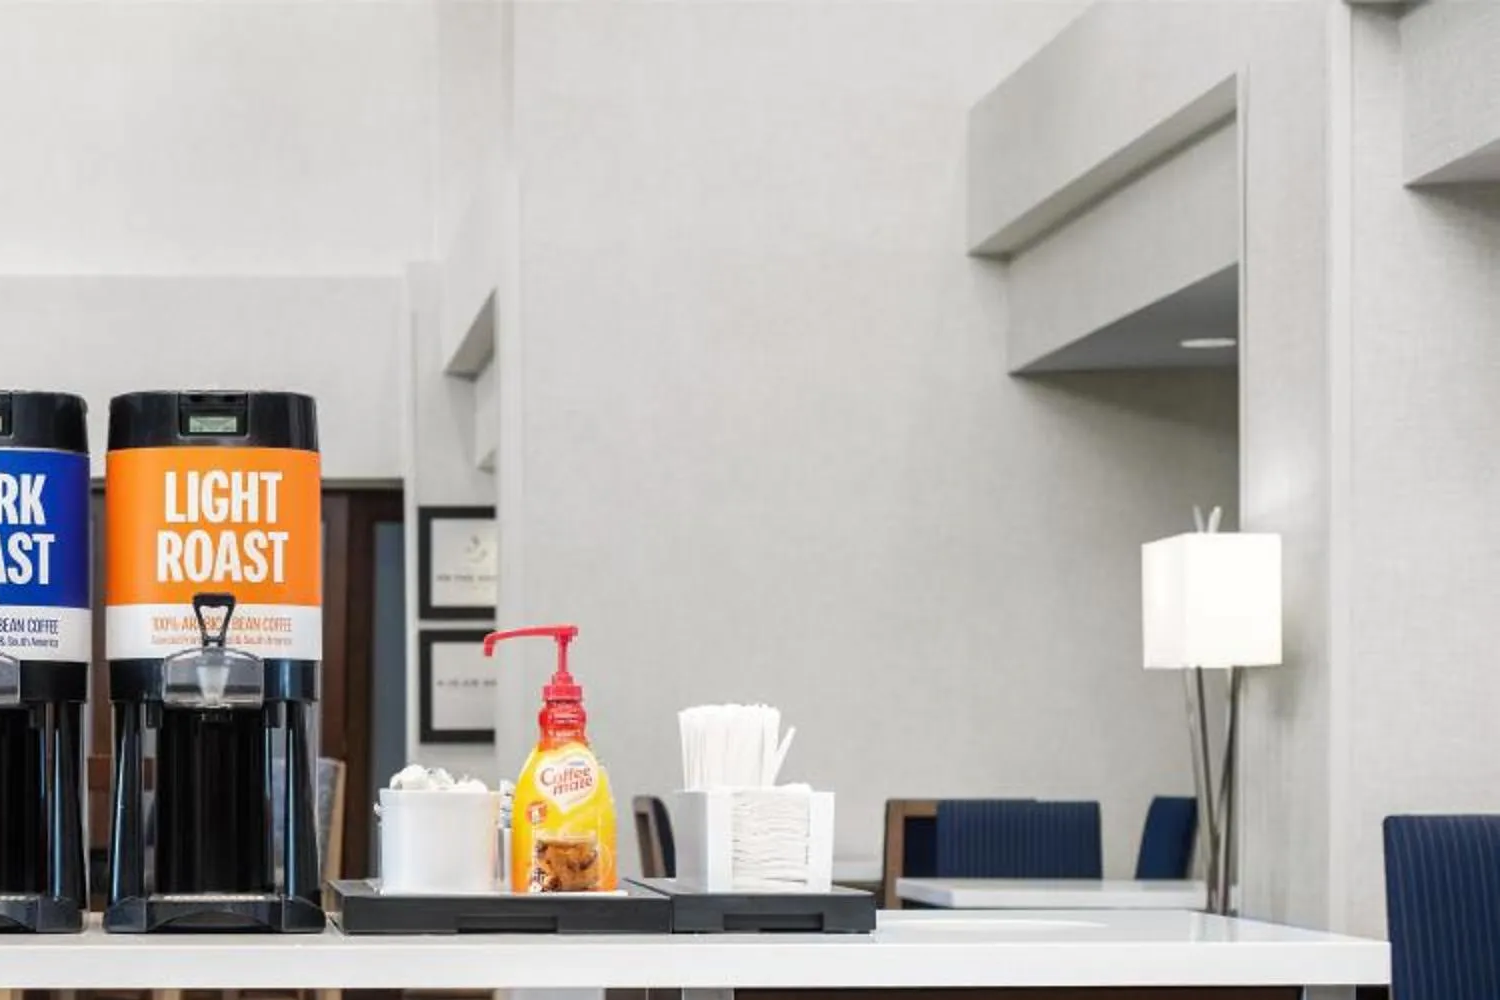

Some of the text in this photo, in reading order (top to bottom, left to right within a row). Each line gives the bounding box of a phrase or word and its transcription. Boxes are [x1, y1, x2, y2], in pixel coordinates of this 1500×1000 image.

[166, 471, 281, 522] LIGHT
[158, 530, 288, 581] ROAST
[27, 619, 59, 635] COFFEE
[232, 616, 260, 632] BEAN
[263, 616, 292, 632] COFFEE
[8, 636, 30, 647] South
[540, 766, 591, 787] Coffee
[553, 775, 593, 798] mate
